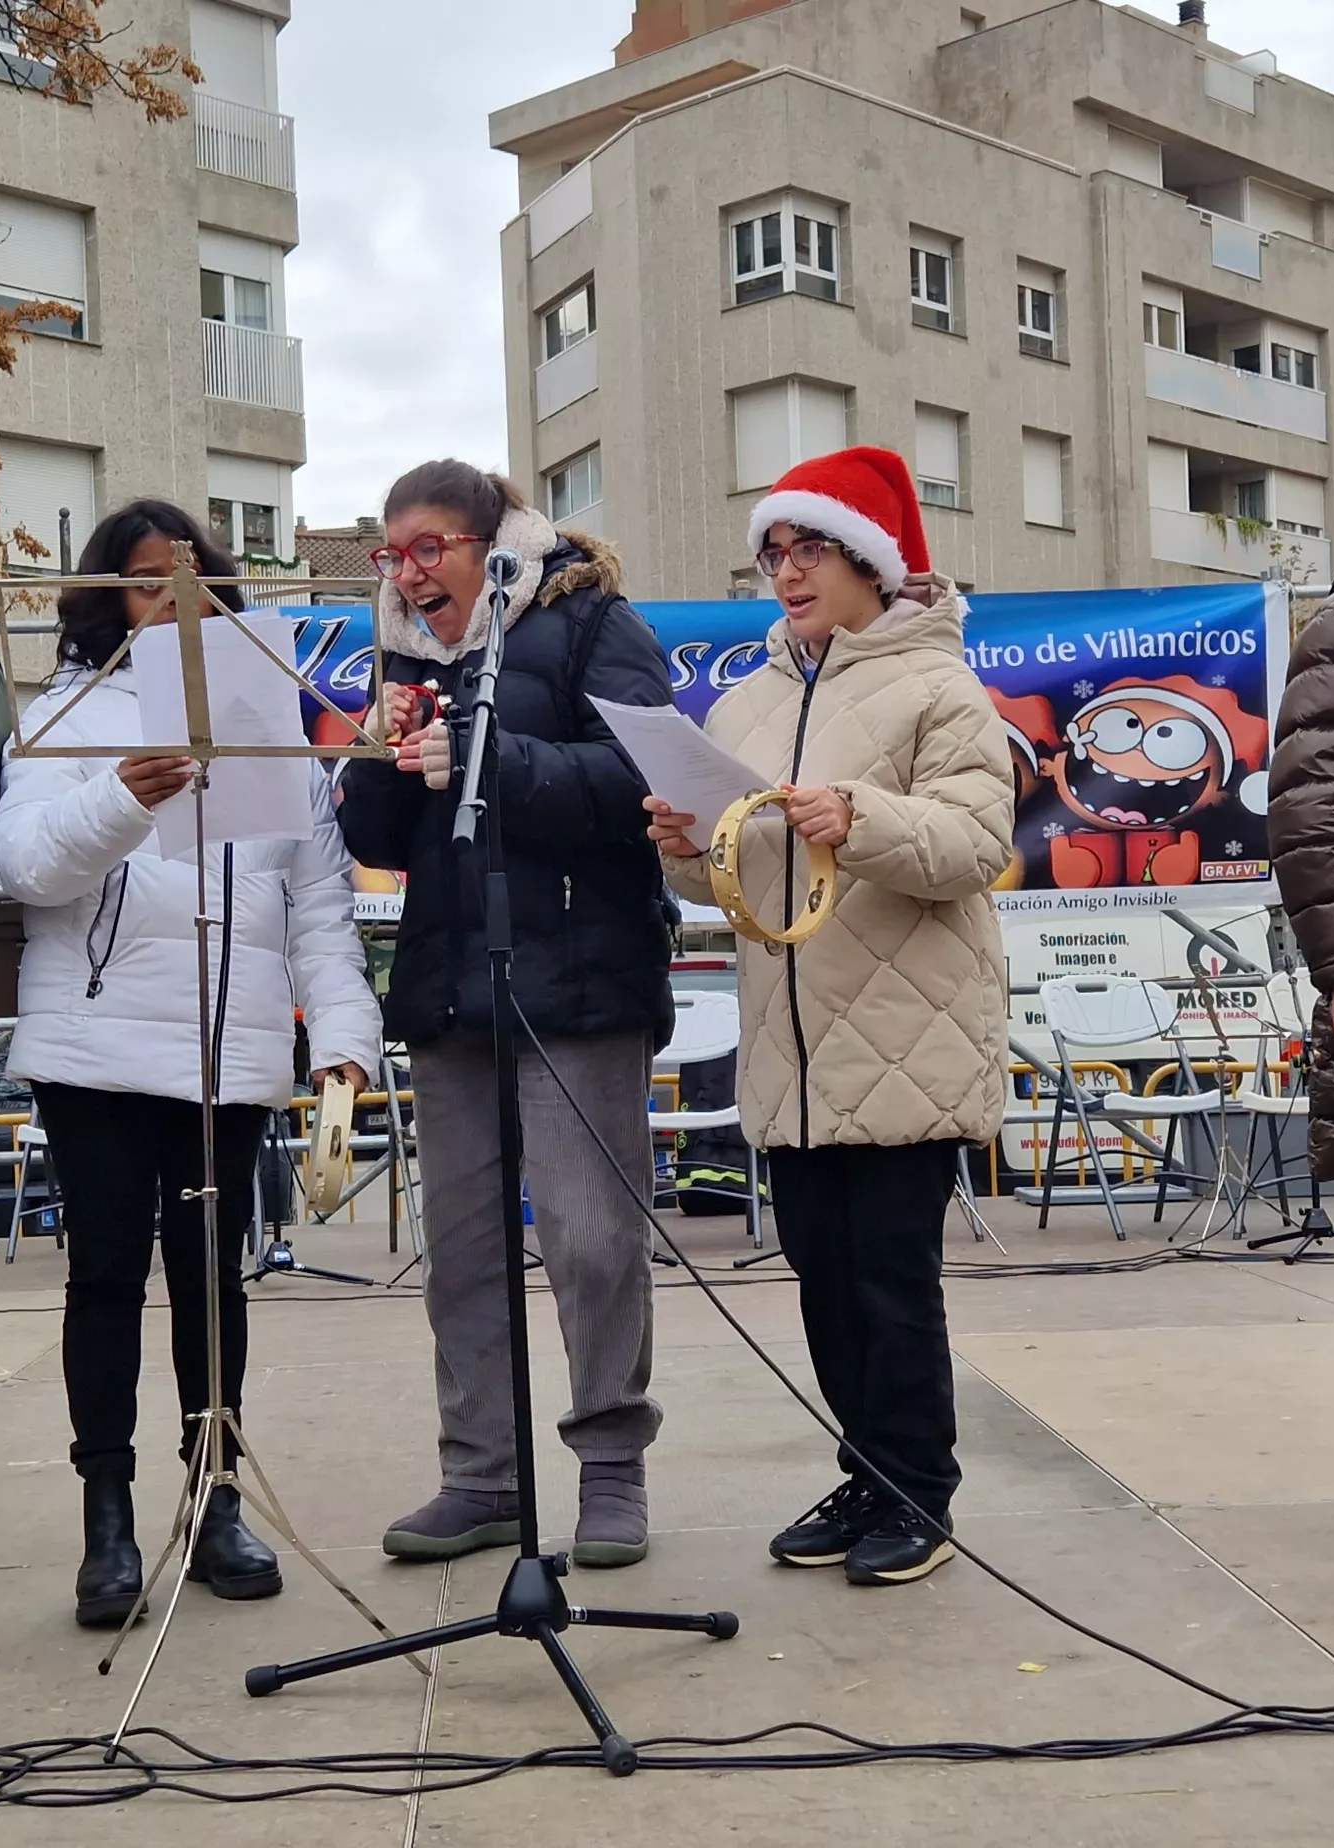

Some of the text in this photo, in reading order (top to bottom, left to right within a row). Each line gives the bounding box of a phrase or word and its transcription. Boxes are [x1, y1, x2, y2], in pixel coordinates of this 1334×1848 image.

[1036, 633, 1077, 664] de
[1083, 620, 1257, 660] Villancicos
[1204, 863, 1257, 877] GRAFVI
[993, 895, 1053, 912] ciación
[1057, 895, 1108, 912] Amigo
[1113, 891, 1178, 908] Invisible
[1039, 931, 1130, 947] Sonorización,
[1055, 952, 1117, 967] Imagen e
[1176, 991, 1257, 1009] MORED
